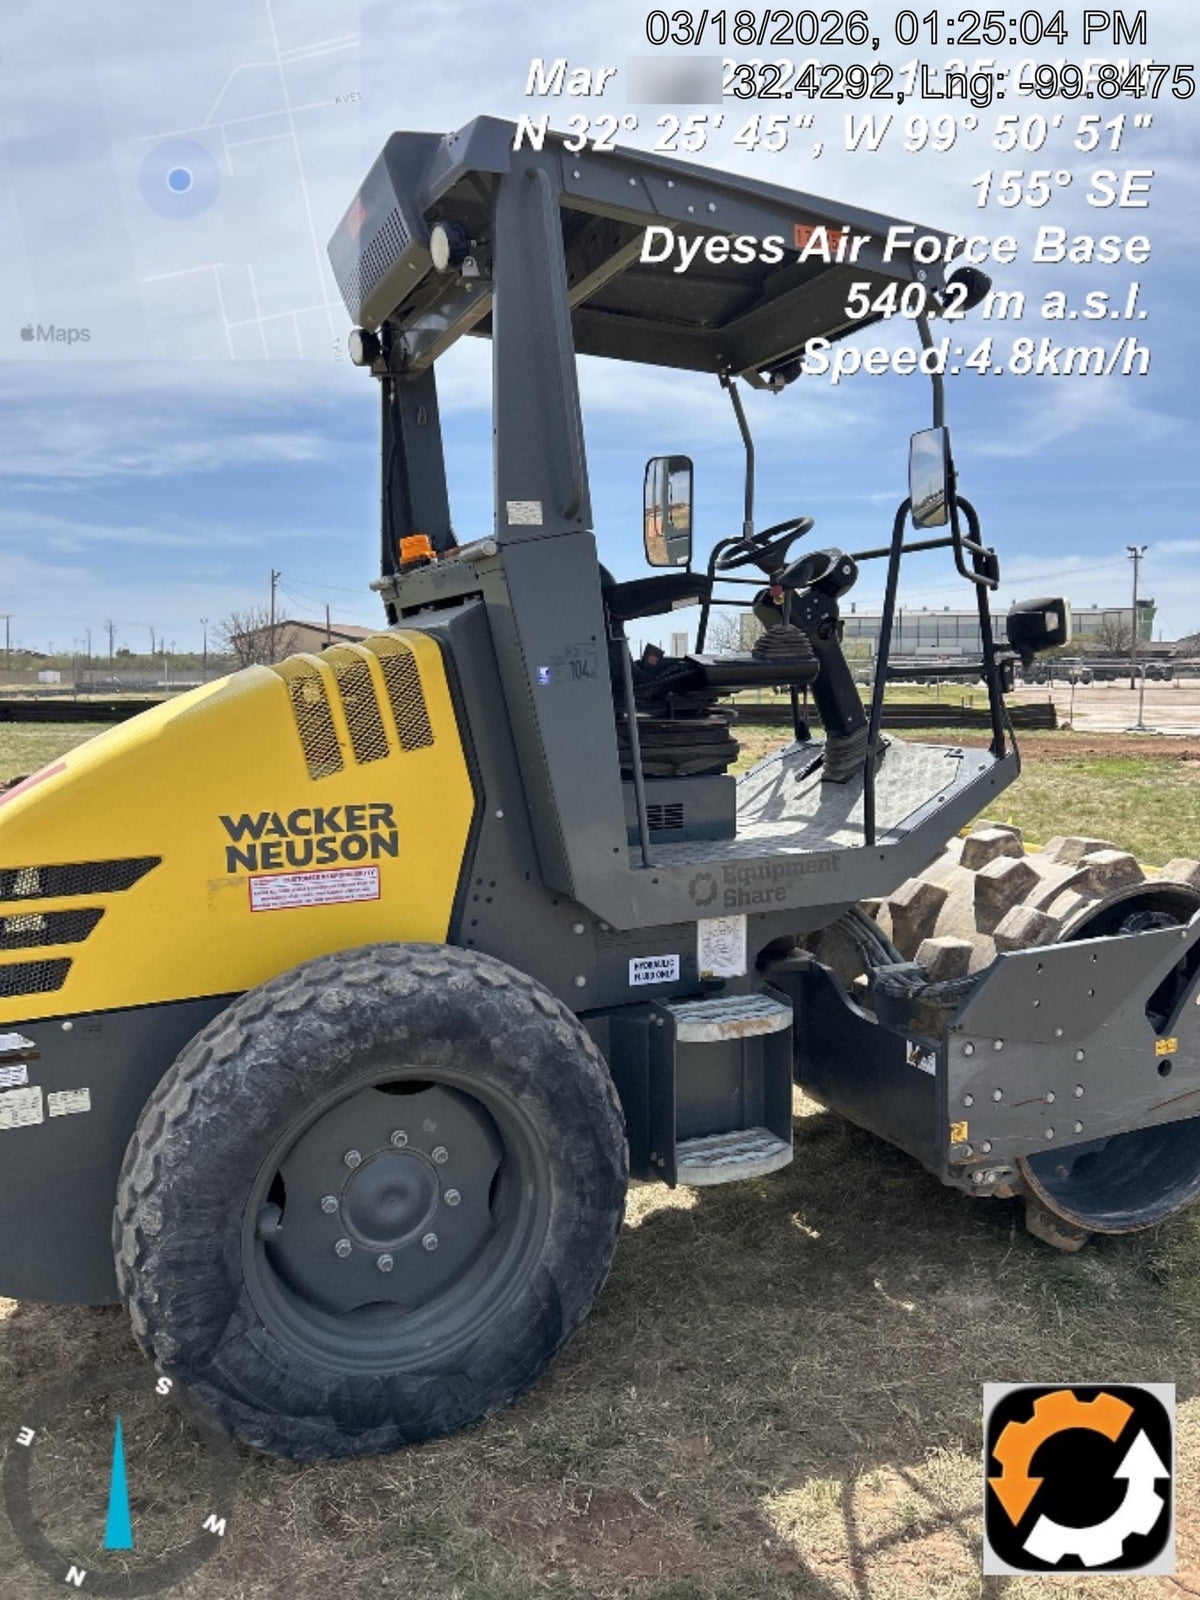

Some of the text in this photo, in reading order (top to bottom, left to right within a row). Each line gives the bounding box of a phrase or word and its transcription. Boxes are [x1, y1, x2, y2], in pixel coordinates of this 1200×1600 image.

[218, 803, 396, 843] WACKER
[225, 830, 399, 873] NEUSON
[721, 853, 841, 886] Equipment
[723, 886, 788, 910] Share
